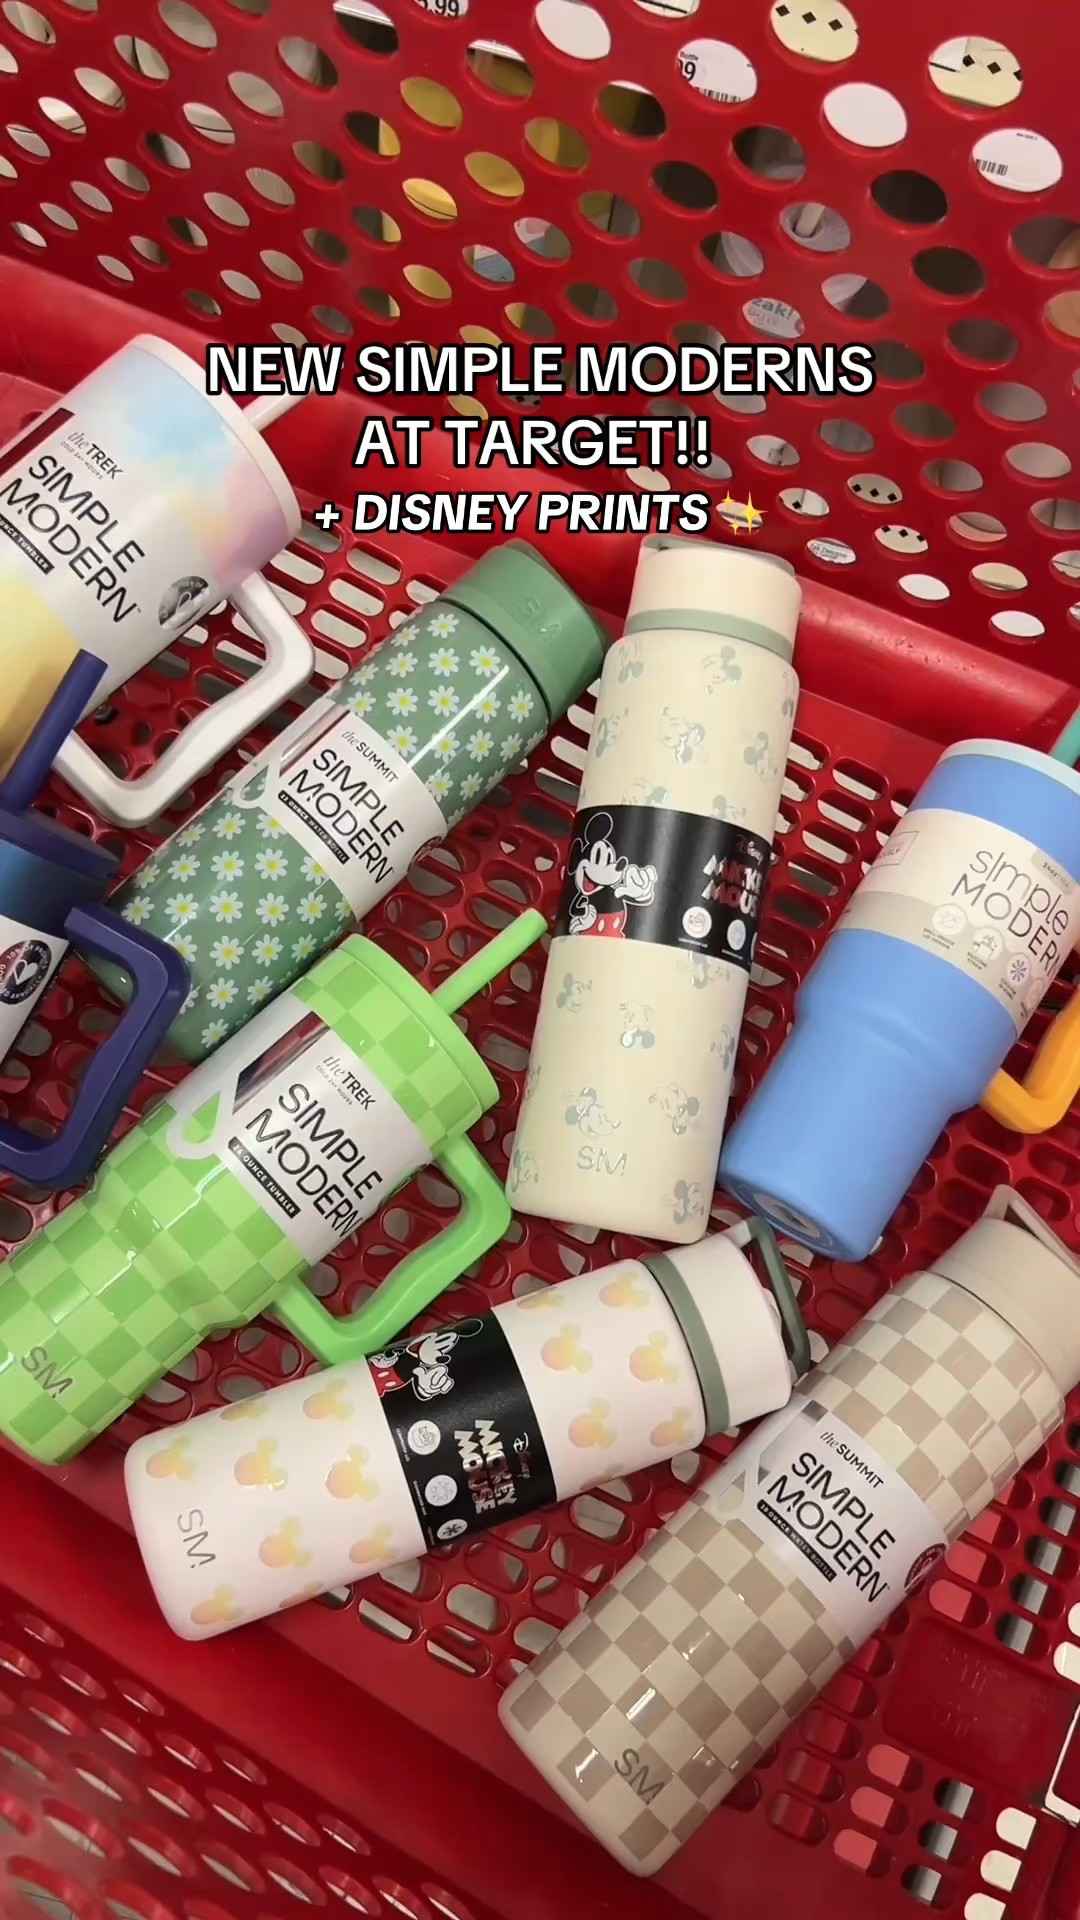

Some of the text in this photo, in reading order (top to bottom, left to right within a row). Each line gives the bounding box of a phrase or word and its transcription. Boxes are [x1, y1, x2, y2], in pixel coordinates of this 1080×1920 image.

[67, 432, 123, 480] the TREK
[0, 478, 138, 623] MODERN
[29, 455, 145, 573] SIMPLE
[17, 536, 50, 570] TUMBLER
[342, 731, 399, 784] the SUMMIT
[288, 769, 393, 883] MODERN
[313, 749, 404, 847] SIMPLE
[307, 819, 328, 840] WATER
[325, 838, 348, 861] BOTTLE
[323, 1056, 376, 1110] the TREK
[245, 1108, 363, 1237] MODERN
[278, 1083, 383, 1200] SIMPLE
[241, 1154, 268, 1182] OUNCE
[265, 1181, 296, 1214] TUMBLER
[21, 1346, 73, 1398] SM
[454, 1430, 496, 1514] MOUSE
[475, 1420, 517, 1505] MICKEY
[820, 1431, 884, 1488] the SUMMIT
[767, 1475, 888, 1603] MODERN
[767, 1510, 790, 1533] OUNCE
[789, 1531, 812, 1554] WATER
[808, 1553, 833, 1578] BOTTLE
[791, 1452, 896, 1560] SIMPLE
[614, 1748, 665, 1805] SM
